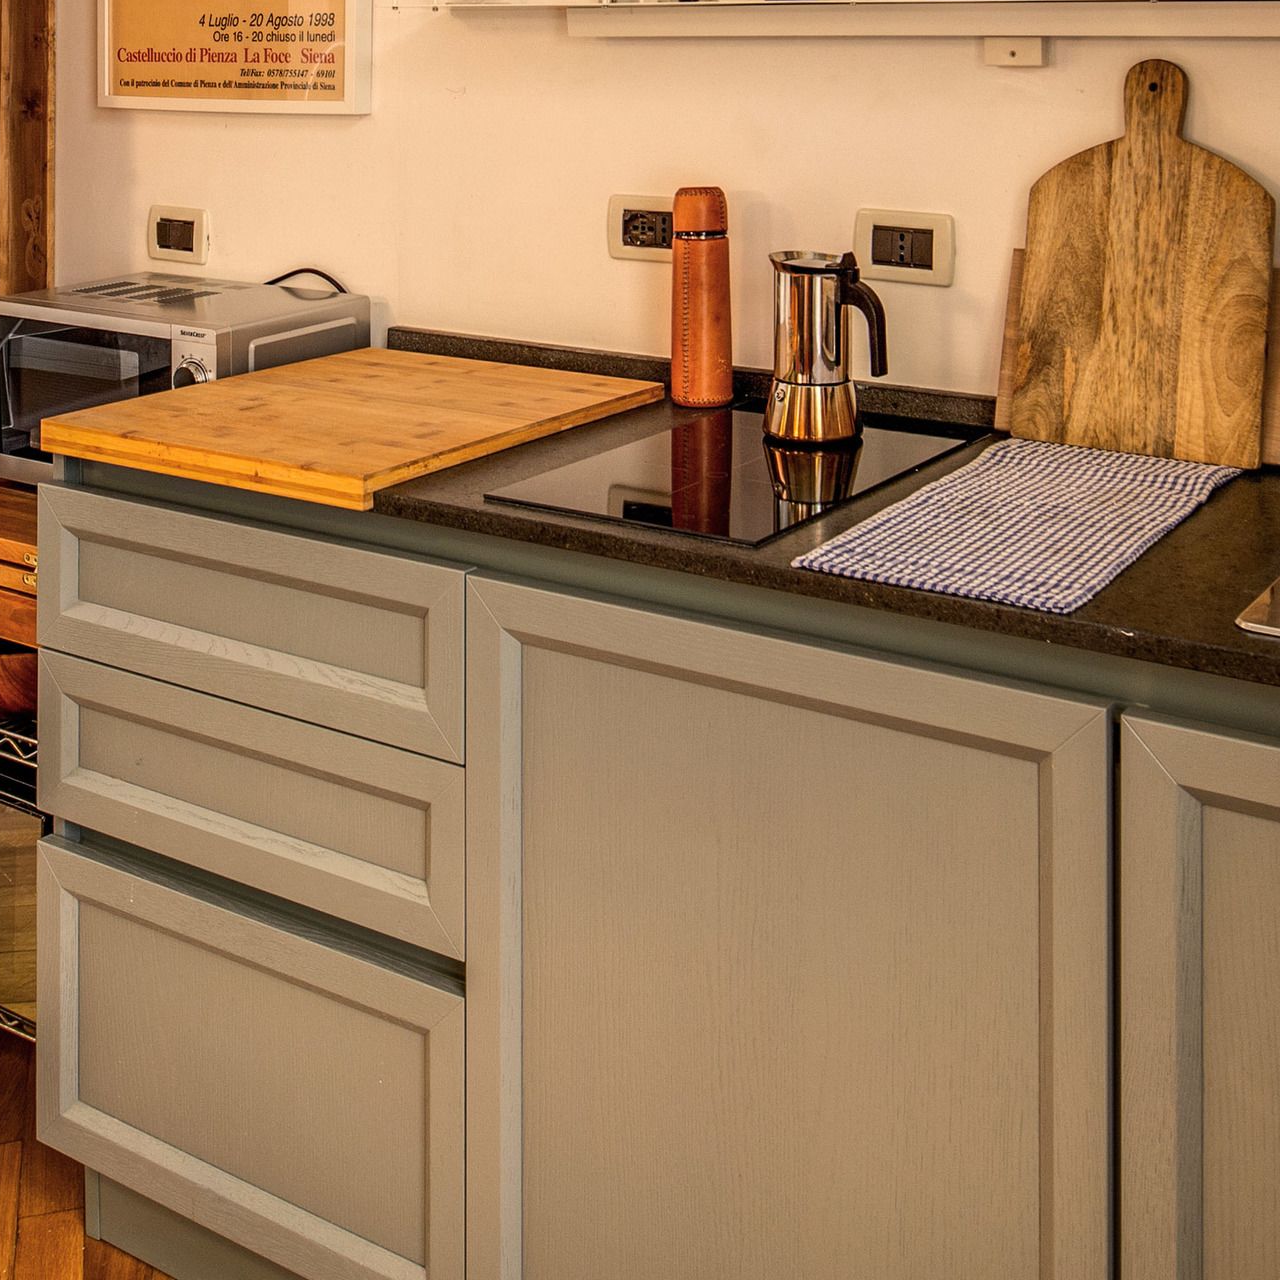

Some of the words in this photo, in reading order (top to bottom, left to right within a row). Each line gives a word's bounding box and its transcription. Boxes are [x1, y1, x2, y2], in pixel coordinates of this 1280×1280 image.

[198, 14, 205, 27] 4
[208, 13, 240, 29] Luglio
[249, 14, 263, 27] 20
[266, 13, 304, 28] Agosto
[308, 13, 335, 27] 1998
[213, 31, 230, 42] Ore
[233, 31, 243, 42] 16
[252, 31, 263, 42] 20
[266, 31, 296, 42] chiuso
[299, 31, 304, 42] il
[117, 48, 183, 63] Castelluccio
[185, 48, 196, 63] di
[200, 49, 238, 64] Pienza
[244, 49, 260, 64] La
[264, 48, 291, 64] Foce
[300, 48, 335, 64] Siena
[267, 69, 308, 77] 0578/755147
[316, 70, 336, 78] 69101
[120, 79, 130, 87] Con
[131, 79, 134, 87] il
[200, 80, 217, 88] Pienza
